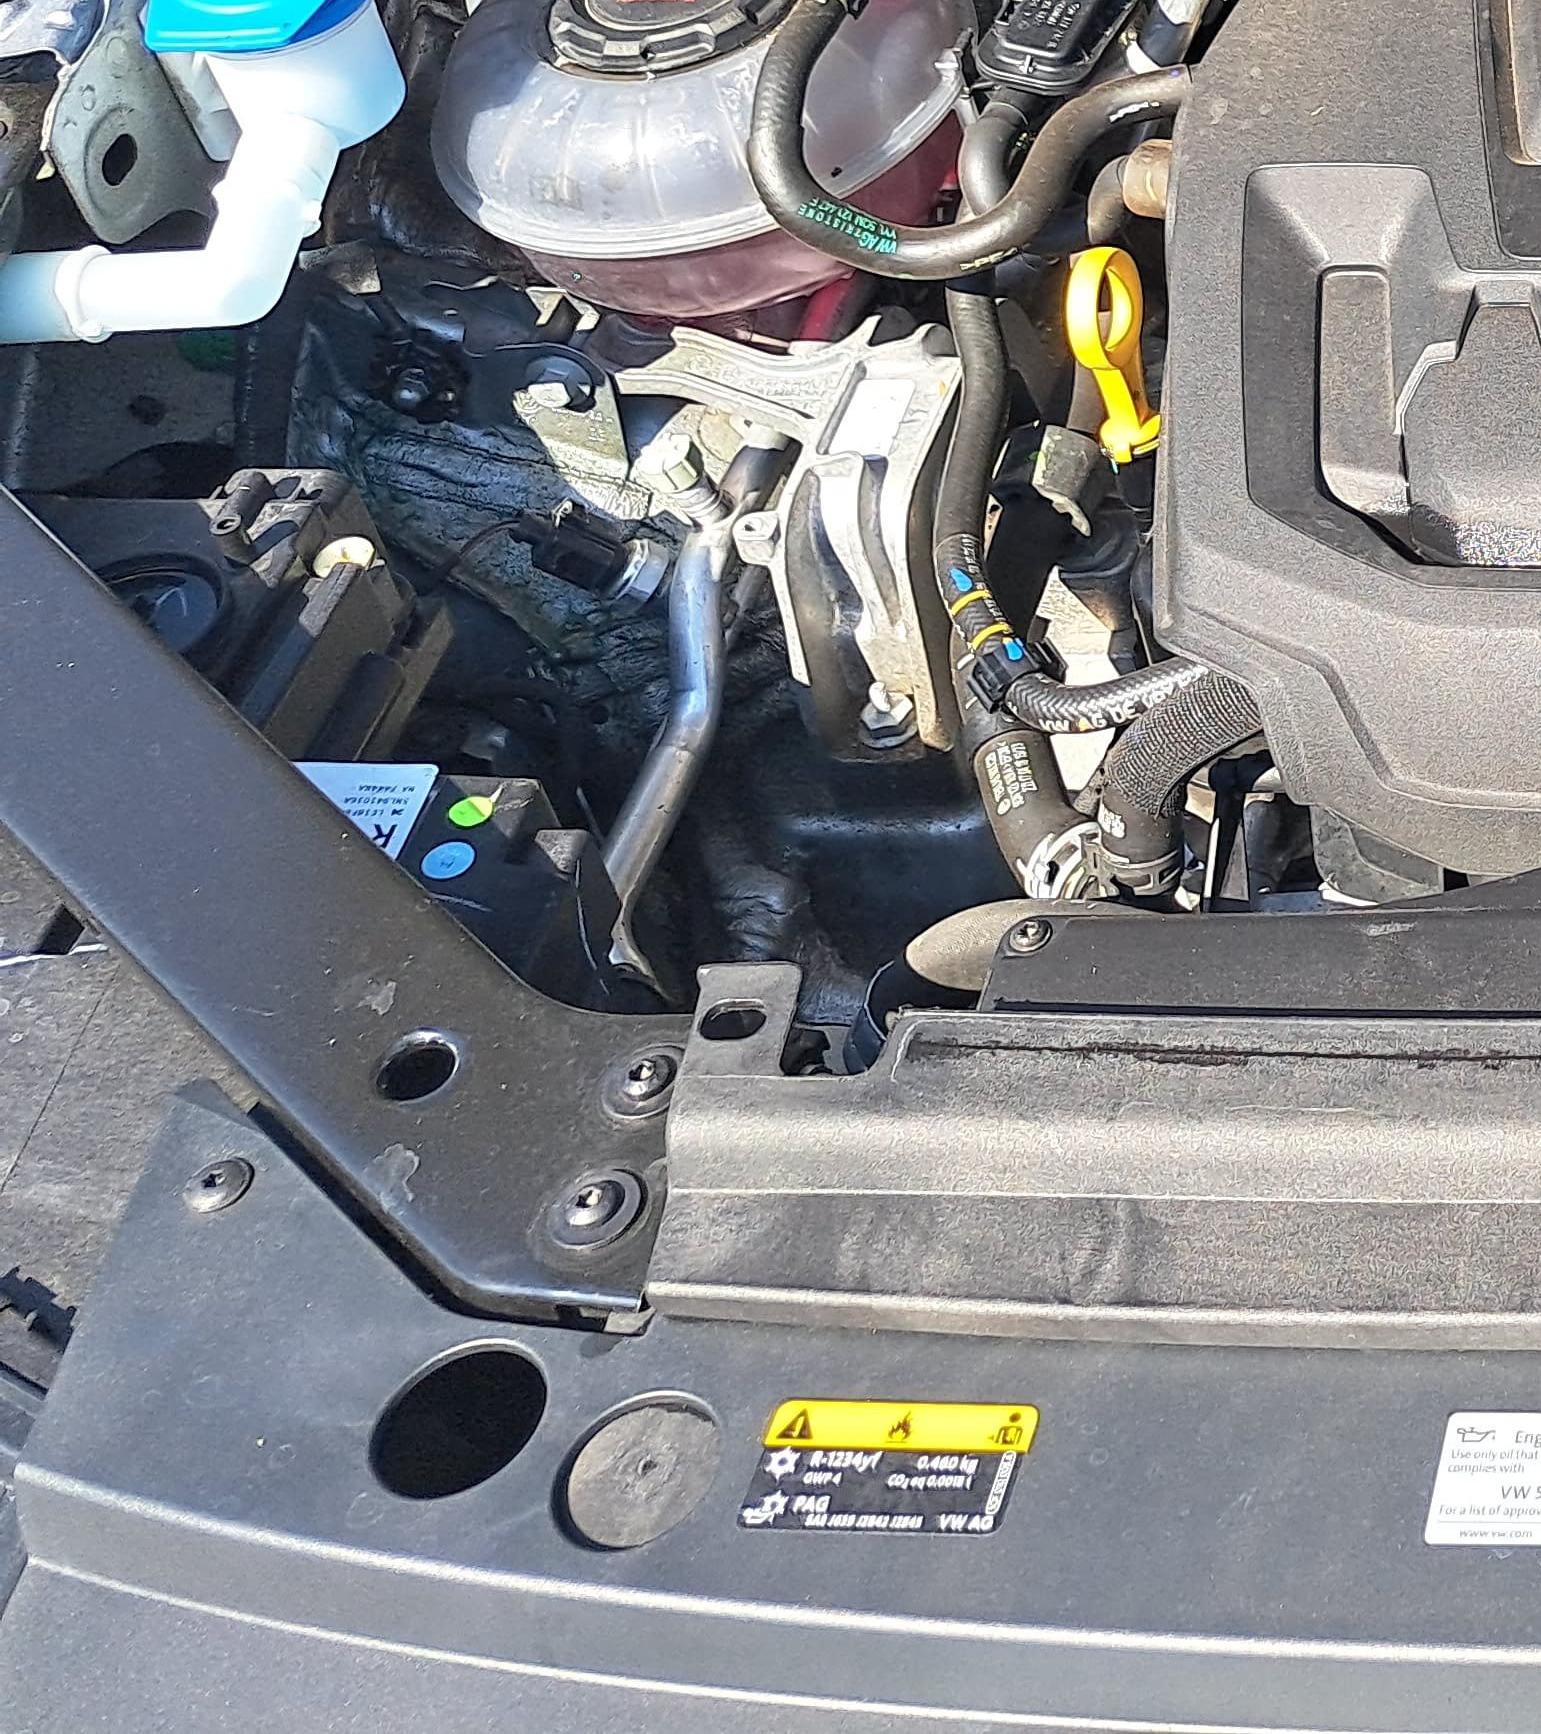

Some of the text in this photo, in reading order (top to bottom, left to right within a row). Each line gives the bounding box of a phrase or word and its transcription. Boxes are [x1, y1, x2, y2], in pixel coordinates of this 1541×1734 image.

[797, 203, 861, 237] TRISTONE
[875, 238, 896, 253] VW
[373, 824, 398, 848] K
[810, 1451, 883, 1472] R-1234yf
[1451, 1449, 1471, 1459] Use
[1474, 1450, 1497, 1460] only
[1500, 1450, 1514, 1459] oil
[1516, 1450, 1538, 1459] that
[1448, 1465, 1496, 1475] complies
[1500, 1465, 1525, 1473] with
[1501, 1485, 1531, 1499] VW
[792, 1495, 831, 1514] PAG
[1439, 1505, 1456, 1516] For
[1459, 1507, 1466, 1516] a
[1469, 1505, 1486, 1516] list
[1489, 1505, 1501, 1516] of
[938, 1515, 967, 1530] VW
[967, 1515, 994, 1530] AG
